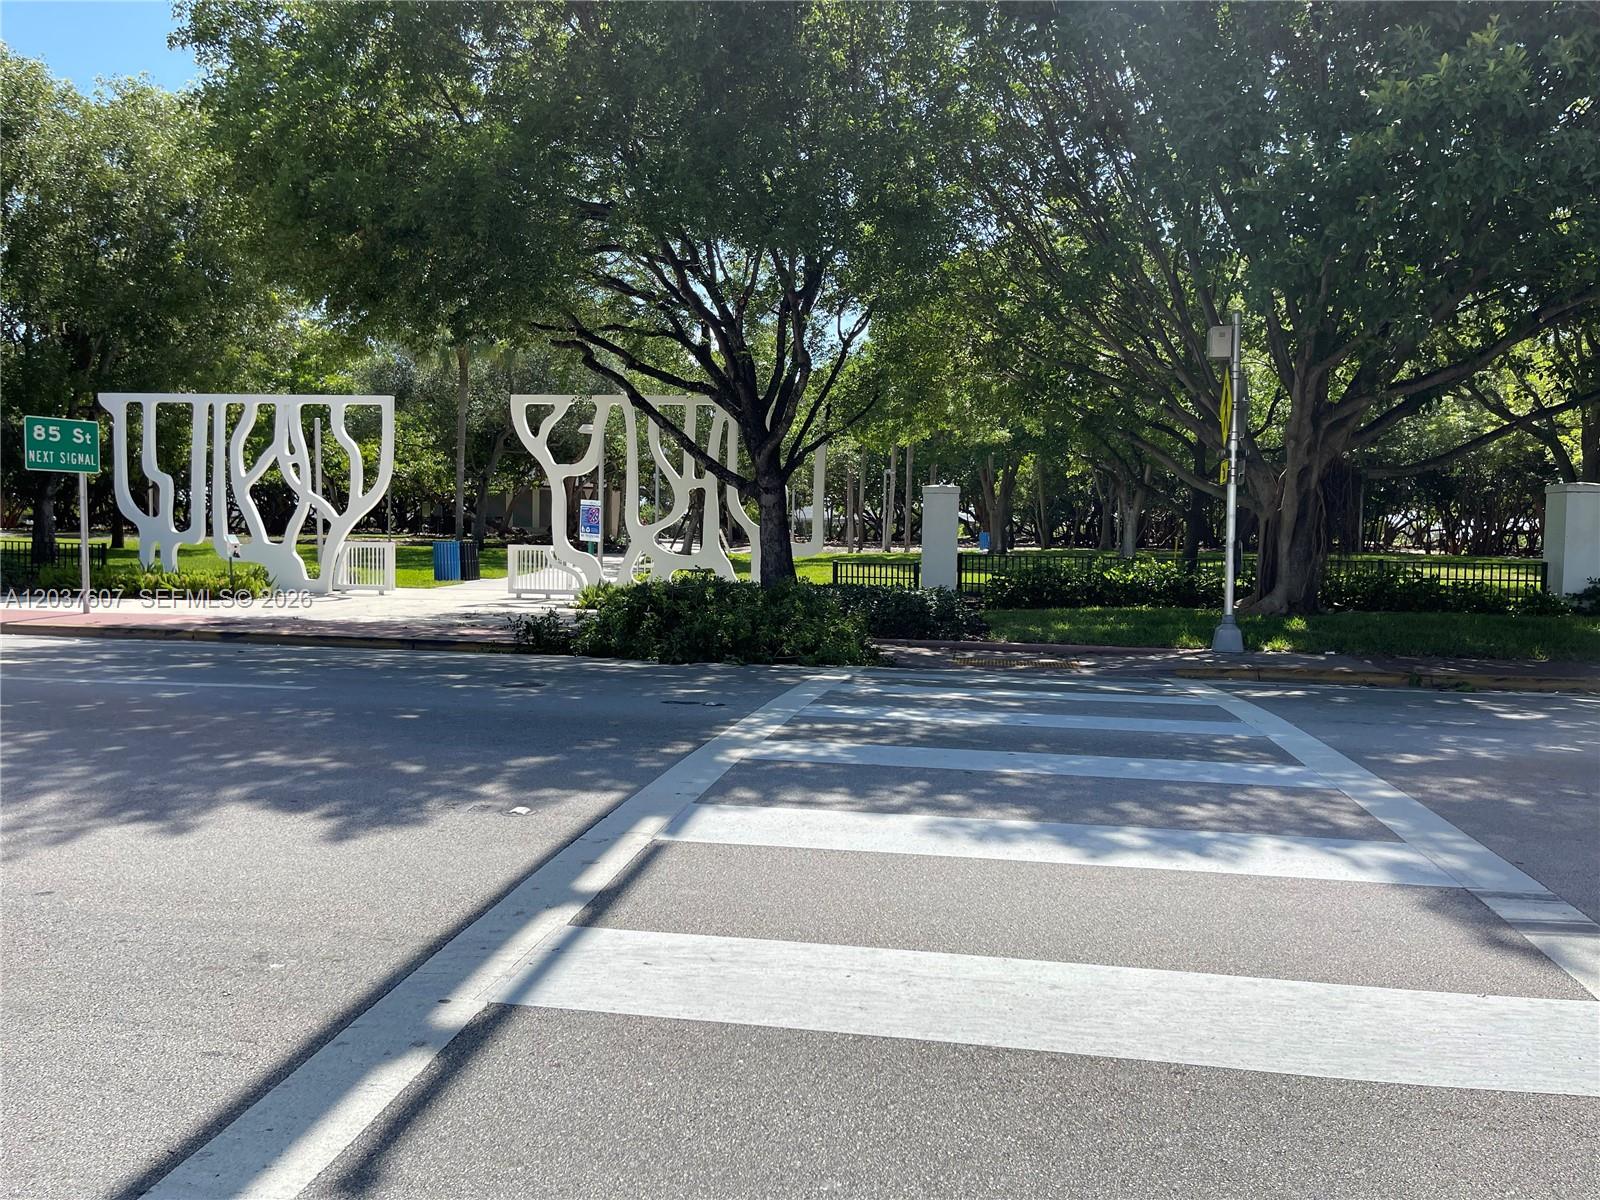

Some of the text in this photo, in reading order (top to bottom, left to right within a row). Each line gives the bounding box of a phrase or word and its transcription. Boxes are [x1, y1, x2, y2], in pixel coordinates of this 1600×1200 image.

[33, 424, 92, 445] 85 St
[28, 449, 97, 466] NEXT SIGNAL
